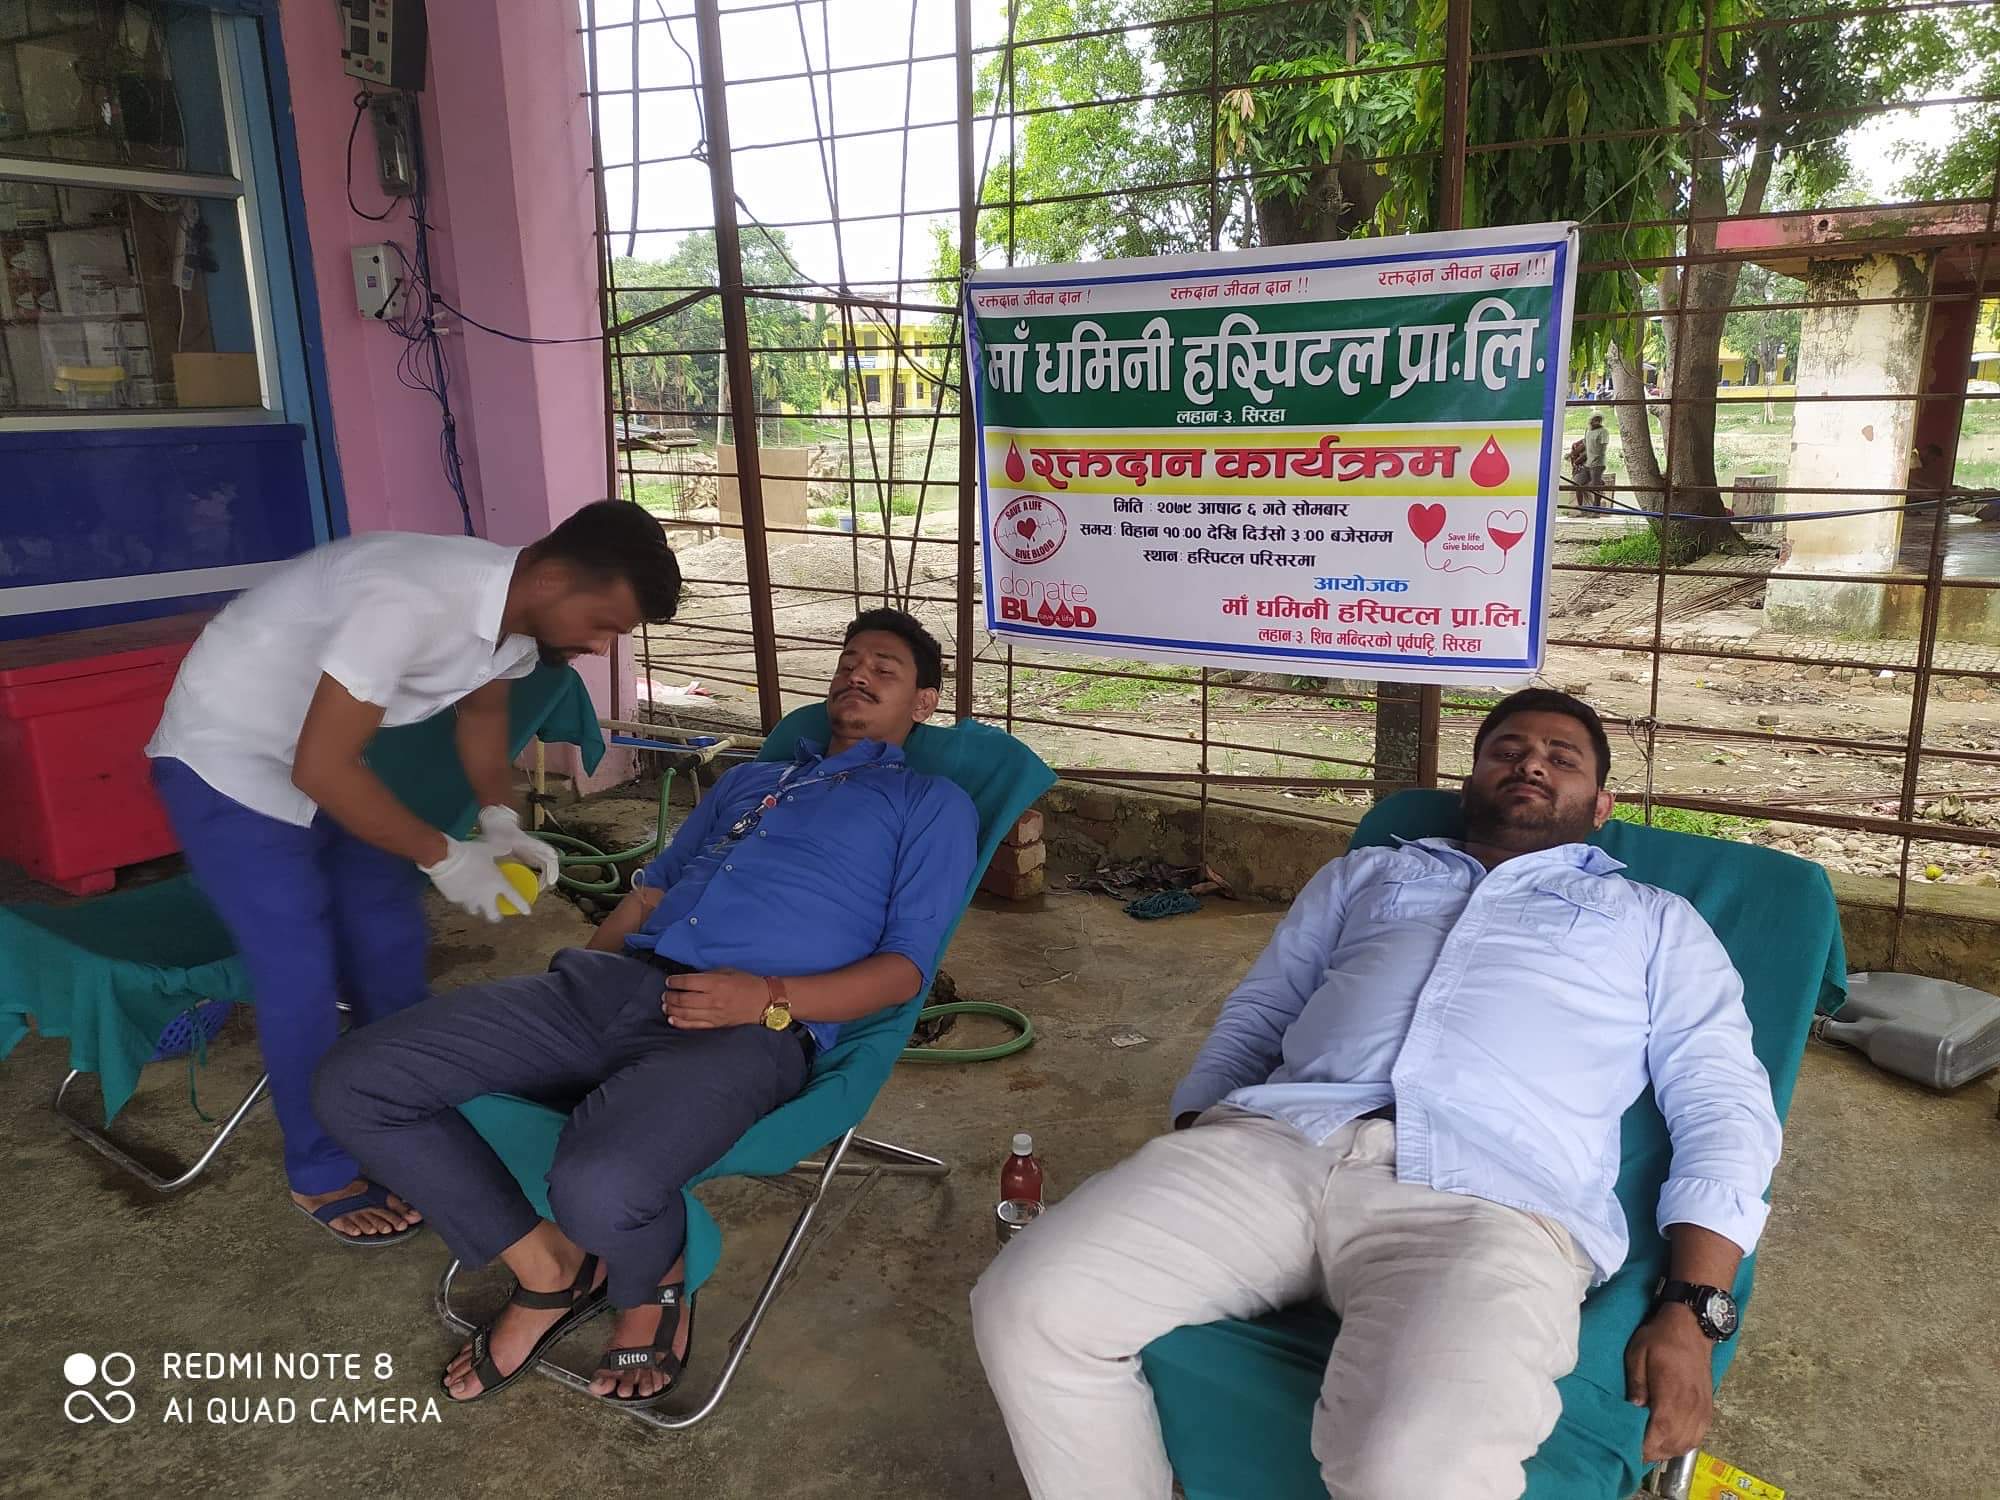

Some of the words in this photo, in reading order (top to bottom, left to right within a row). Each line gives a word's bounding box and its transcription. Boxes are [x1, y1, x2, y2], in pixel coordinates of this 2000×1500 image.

[1378, 268, 1436, 287] रक्तदान
[1440, 262, 1484, 281] जीवन
[1490, 262, 1521, 281] दान
[978, 294, 1019, 308] रक्तदान
[1023, 289, 1054, 306] जीवन
[1059, 290, 1082, 306] दान
[1170, 284, 1219, 300] रक्तदान
[1224, 280, 1260, 297] जीवन
[1265, 280, 1291, 297] दान
[985, 319, 1029, 393] माँ
[1035, 316, 1175, 394] धमिनी
[1182, 312, 1391, 405] हस्पिटल
[1390, 297, 1545, 399] प्रा.लि.
[1242, 405, 1287, 423] सिरहा
[1030, 446, 1206, 490] रक्तदान
[1214, 434, 1461, 482] कार्यक्रम
[1005, 504, 1022, 521] SAVE
[1023, 501, 1029, 511] A
[1029, 501, 1042, 511] LIFE
[1113, 497, 1143, 513] मिति
[1157, 502, 1192, 514] २०७९
[1197, 502, 1242, 515] आषाढ
[1247, 503, 1256, 516] ६
[1263, 500, 1286, 516] गते
[1292, 500, 1350, 517] सोमबार
[1207, 524, 1237, 541] देखि
[1330, 526, 1393, 543] बजेसम्म
[1447, 534, 1466, 542] Save
[1467, 533, 1480, 541] life
[1015, 548, 1031, 559] GIVE
[1032, 539, 1055, 559] BLOOD
[1442, 542, 1460, 550] Give
[1461, 542, 1484, 551] blood
[1187, 548, 1244, 565] हस्पिटल
[1249, 549, 1316, 567] परिसरमा
[1000, 567, 1088, 602] donate
[1314, 574, 1410, 593] आयोजक
[1222, 594, 1249, 616] माँ
[1256, 595, 1330, 620] धमिनी
[1338, 598, 1442, 625] हस्पिटल
[1451, 602, 1526, 628] प्रा.लि.
[1311, 627, 1333, 645] शिव
[1336, 629, 1392, 648] मन्दिरको
[1443, 633, 1481, 653] सिरहा
[618, 1351, 648, 1366] Kitto
